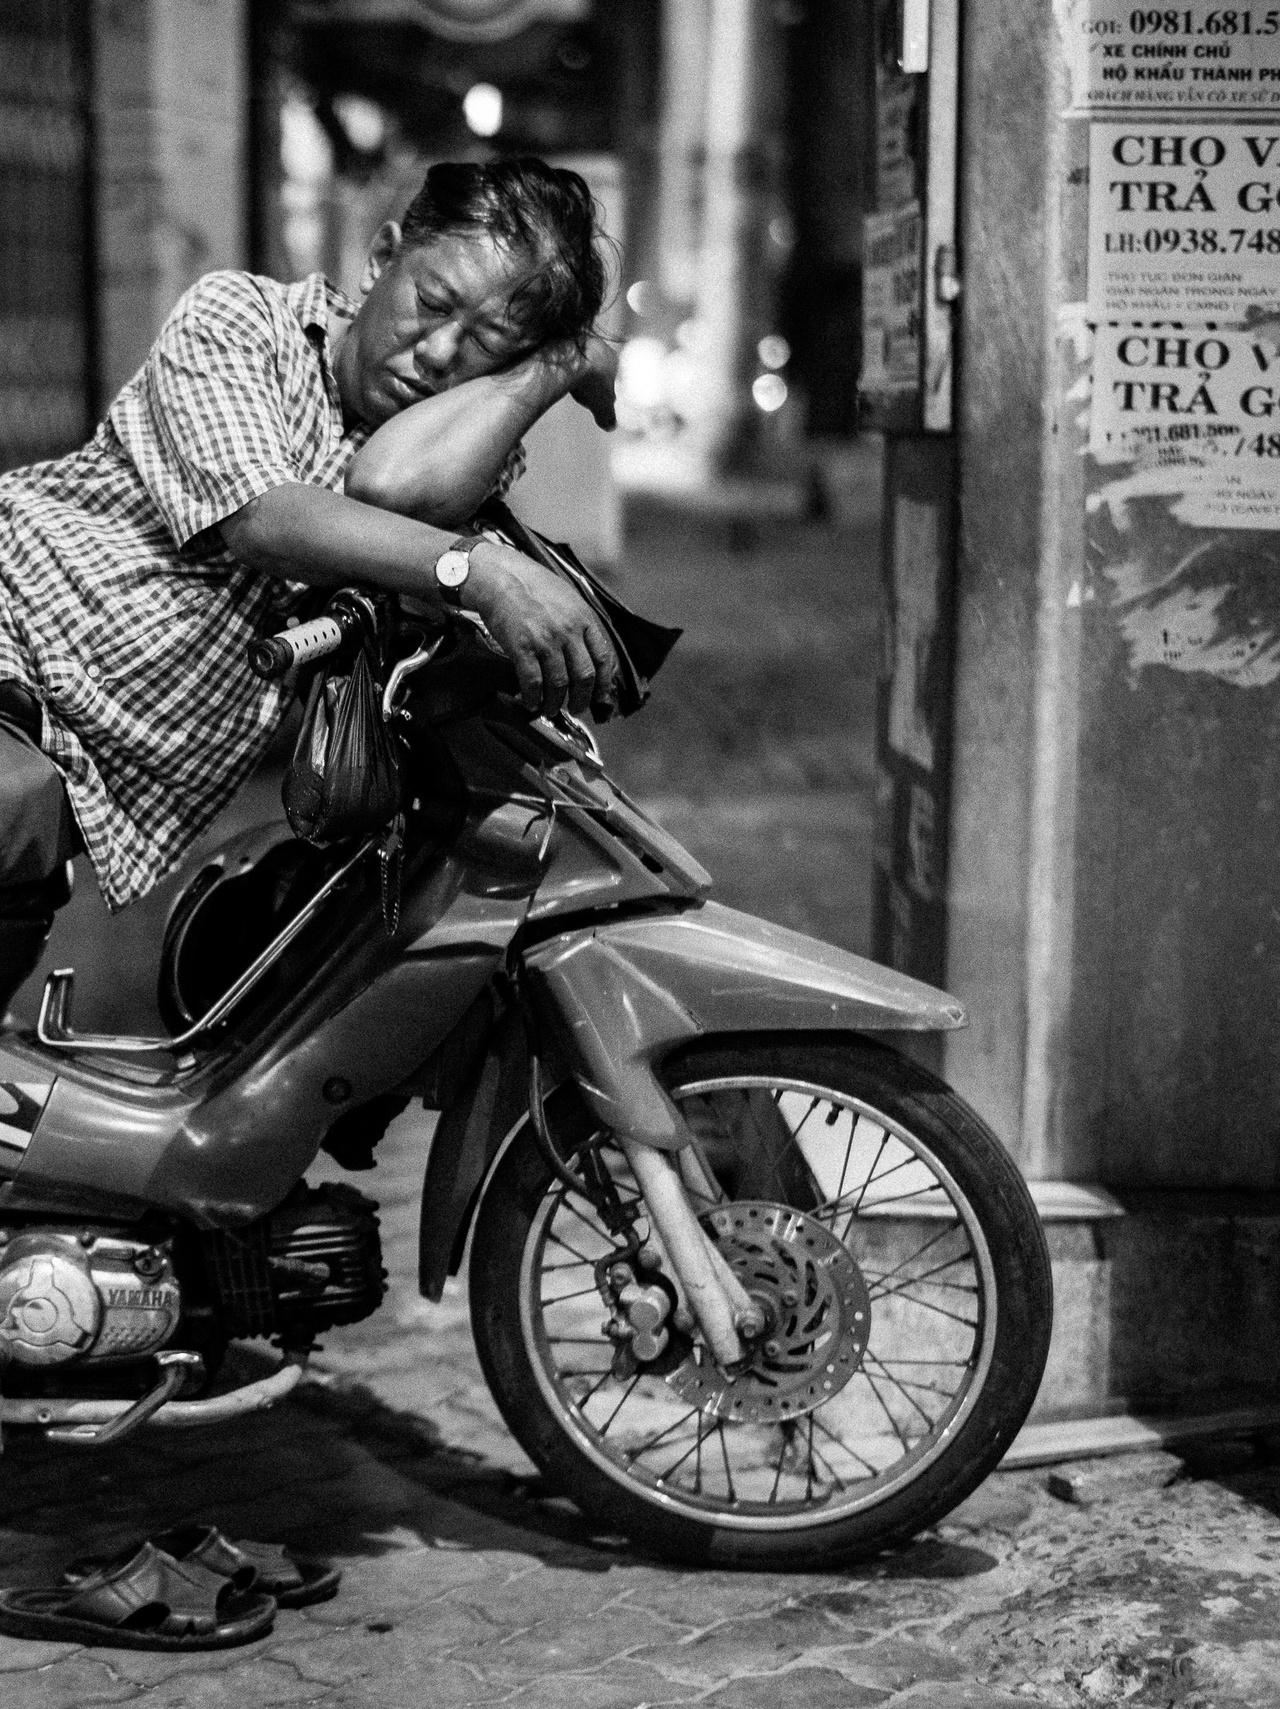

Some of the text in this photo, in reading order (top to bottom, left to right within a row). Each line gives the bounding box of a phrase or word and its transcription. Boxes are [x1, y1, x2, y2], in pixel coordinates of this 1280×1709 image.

[1129, 9, 1280, 35] 0981.681.5
[1103, 40, 1231, 58] XE CHÍNH CHỦ
[1102, 64, 1127, 83] HỘ
[1134, 61, 1185, 81] KHẨU
[1190, 65, 1252, 81] THÀNH
[1111, 135, 1280, 168] CHO V
[1109, 168, 1280, 213] TRẢ G
[1117, 335, 1231, 371] CHO
[1113, 371, 1280, 418] TRẢ G
[107, 1288, 172, 1306] YAMAHA
